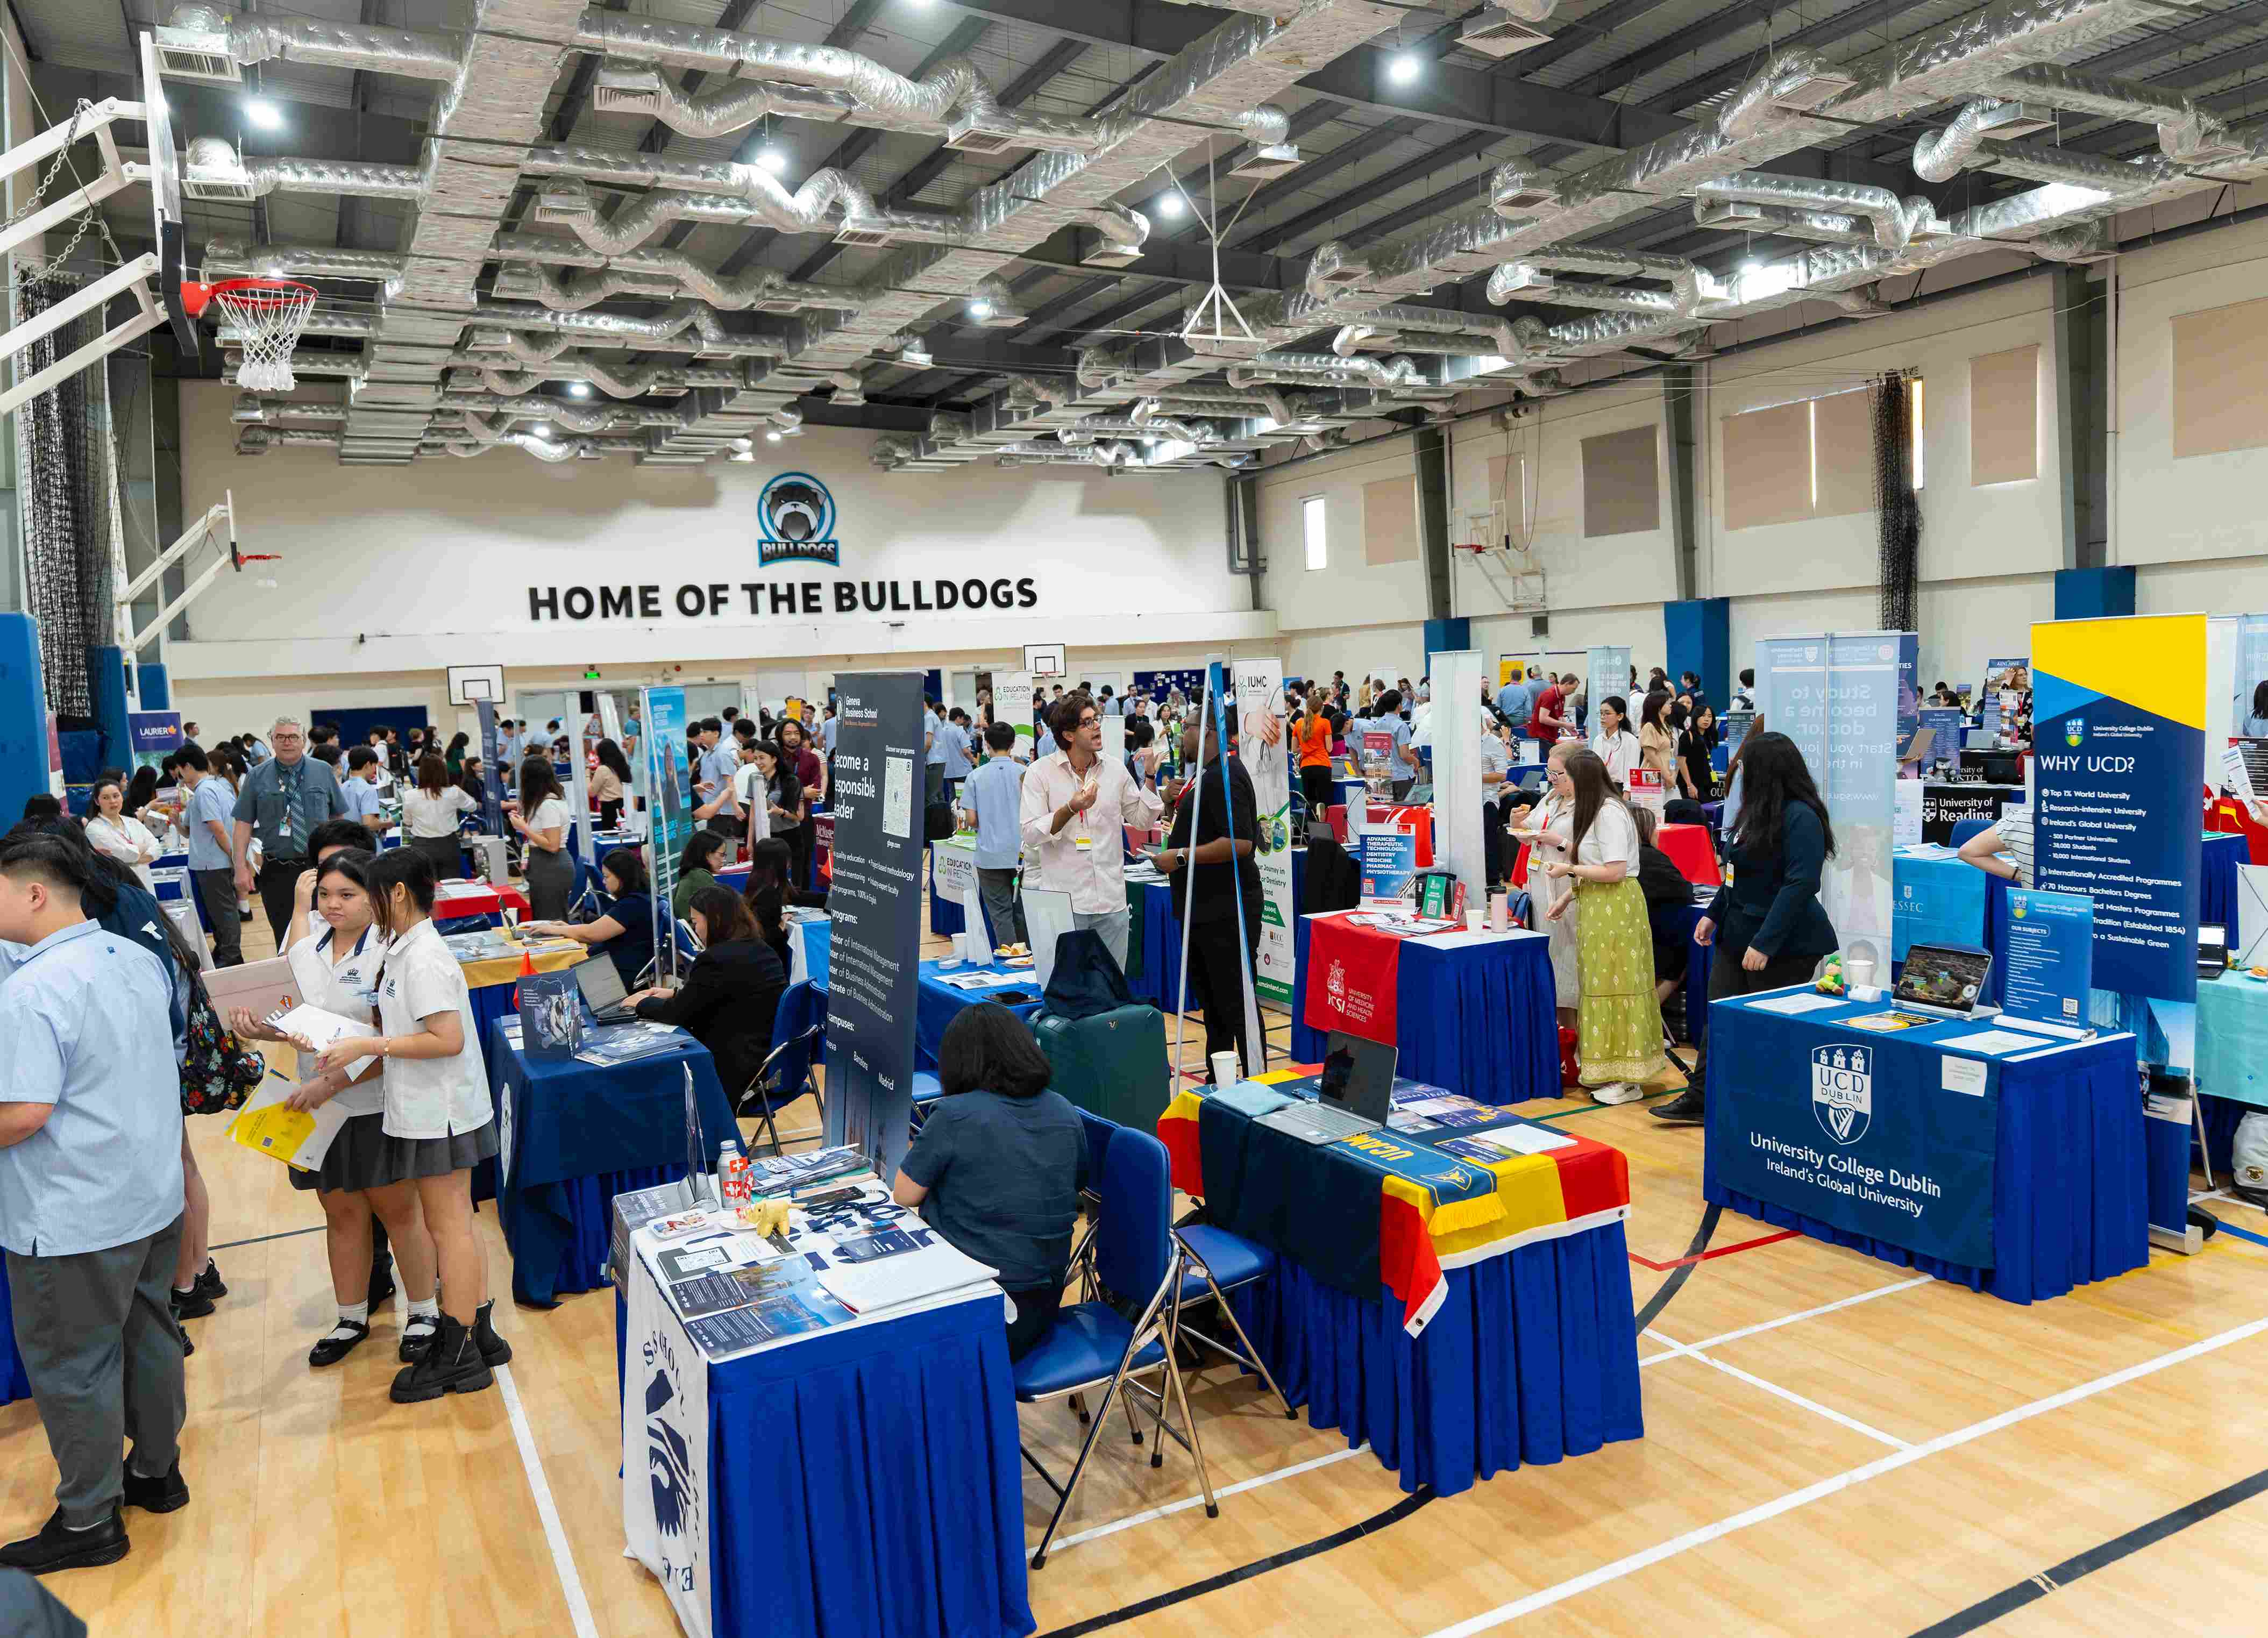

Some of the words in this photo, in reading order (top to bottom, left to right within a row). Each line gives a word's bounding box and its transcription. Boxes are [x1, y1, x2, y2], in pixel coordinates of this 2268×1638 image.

[762, 542, 837, 562] BULLDOGS
[529, 586, 662, 620] HOME
[676, 583, 729, 617] OF
[741, 582, 822, 615] THE
[834, 578, 1038, 613] BULLDOGS
[1248, 676, 1267, 687] IUMC
[845, 695, 861, 706] Geneva
[845, 708, 864, 718] Business
[864, 708, 878, 718] School
[140, 727, 168, 736] LAURIER
[835, 750, 861, 770] ecome
[864, 757, 869, 771] a
[2041, 756, 2080, 771] WHY
[2088, 756, 2135, 773] UCD?
[1961, 766, 1975, 774] rsity
[835, 777, 875, 799] esponsible
[2050, 789, 2061, 797] Top
[2098, 792, 2130, 800] University
[1939, 798, 1982, 808] University
[1984, 797, 1993, 806] of
[1940, 808, 1994, 822] Reading
[2050, 804, 2111, 814] Research-intensive
[2114, 808, 2146, 817] University
[2104, 822, 2136, 831] University
[847, 854, 865, 864] education
[887, 867, 915, 881] methodology
[947, 858, 972, 870] EDUCATION
[1264, 865, 1278, 874] Journey
[847, 872, 865, 884] mentoring
[1267, 877, 1286, 888] Dentistry
[2048, 868, 2096, 879] Internationally
[2098, 873, 2134, 882] Accredited
[2136, 876, 2181, 887] Programmes
[2058, 884, 2087, 893] Honours
[2089, 887, 2122, 896] Bachelors
[2124, 890, 2152, 900] Degrees
[1893, 900, 1924, 912] ESSEC
[2106, 904, 2132, 913] Masters
[2134, 907, 2180, 918] Programmes
[832, 909, 858, 924] programs:
[2092, 917, 2121, 927] Tradition
[2123, 921, 2162, 932] (Established
[2165, 926, 2186, 935] 1854)
[2107, 935, 2145, 945] Sustainable
[2147, 939, 2169, 949] Green
[830, 931, 843, 945] chelor
[844, 937, 850, 946] of
[851, 938, 873, 958] International
[873, 949, 900, 972] Management
[839, 951, 845, 961] of
[846, 953, 871, 973] International
[839, 968, 845, 977] of
[846, 970, 864, 986] Business
[847, 987, 852, 996] of
[853, 988, 868, 1006] Business
[1348, 988, 1372, 1001] UNIVERSITY
[1347, 1003, 1357, 1011] AND
[1357, 1006, 1373, 1018] HEALTH
[1355, 998, 1375, 1010] MEDICINE
[829, 1013, 855, 1031] campuses:
[1346, 1010, 1367, 1022] SCIENCES
[854, 1051, 868, 1071] Barcelona
[878, 1071, 894, 1090] Madrid
[1820, 1067, 1864, 1093] UCD
[1821, 1087, 1862, 1103] DUBLIN
[1342, 1134, 1414, 1162] UCAM
[1750, 1131, 1824, 1169] University
[1829, 1154, 1884, 1185] College
[1889, 1169, 1941, 1198] Dublin
[1767, 1158, 1814, 1183] Ireland's
[1817, 1173, 1855, 1196] Global
[1858, 1185, 1924, 1218] University
